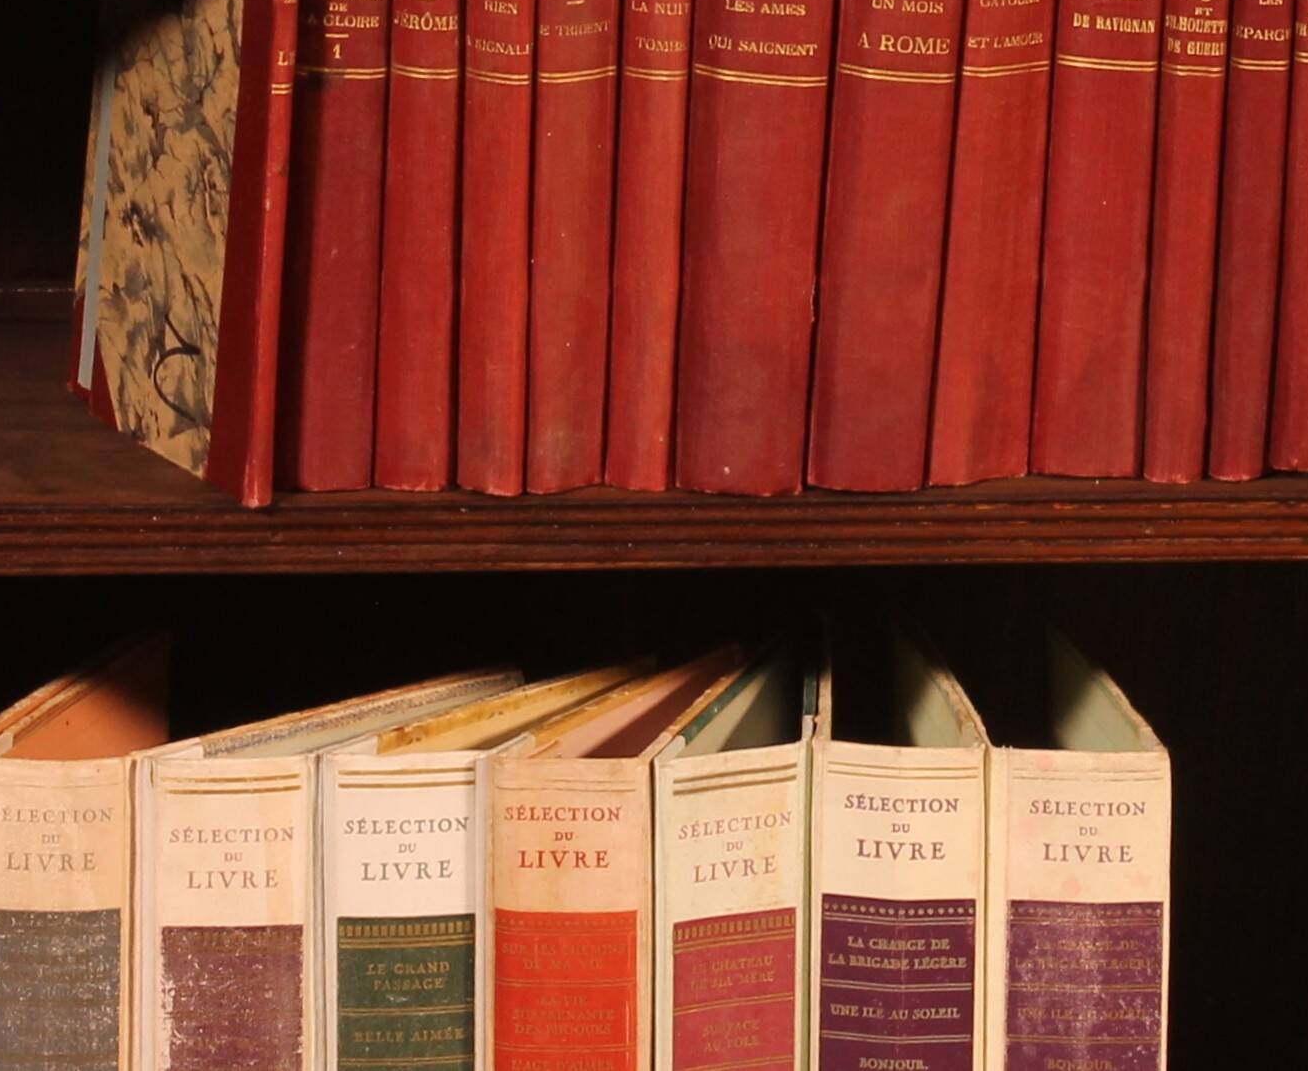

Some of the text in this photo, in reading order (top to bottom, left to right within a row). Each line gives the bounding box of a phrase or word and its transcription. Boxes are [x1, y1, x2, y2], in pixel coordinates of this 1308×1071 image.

[329, 3, 348, 12] DE
[484, 0, 518, 15] RIEN
[631, 0, 649, 12] LA
[761, 4, 806, 16] AMES
[902, 0, 943, 14] MOIS
[323, 15, 379, 27] GLOIRE
[395, 11, 458, 30] JÉRÔME
[1073, 14, 1155, 34] DE RAVIGNAN
[1165, 14, 1227, 34] SILHOUETT
[709, 36, 817, 56] QUI SAIGNENT
[858, 32, 950, 55] A ROME
[968, 32, 1043, 49] ET L'AMOUR
[332, 45, 342, 60] 1
[844, 793, 959, 814] SÉLECTION
[1029, 798, 1146, 818] SÉLECTION
[504, 804, 622, 822] SÉLECTION
[344, 817, 469, 835] SÉLECTION
[678, 810, 792, 841] SÉLECTION
[891, 823, 910, 834] DU
[1079, 826, 1098, 836] DU
[42, 833, 61, 844] DU
[169, 825, 294, 843] SÉLECTION
[554, 831, 574, 842] DU
[398, 842, 417, 853] DU
[726, 841, 743, 851] DU
[856, 839, 947, 860] LIVRE
[1043, 843, 1133, 863] LIVRE
[6, 851, 97, 872] LIVRE
[223, 851, 243, 863] DU
[518, 850, 610, 869] LIVRE
[361, 859, 453, 881] LIVRE
[693, 855, 777, 884] LIVRE
[187, 869, 279, 889] LIVRE
[847, 936, 950, 950] LA CHARGE DE
[366, 960, 450, 976] LE GRAND
[828, 953, 845, 964] LA
[850, 955, 909, 969] BRIGADE
[373, 976, 446, 991] PASSAGE
[830, 1004, 859, 1016] UNE
[889, 1010, 908, 1019] AU
[913, 1008, 960, 1019] SOLEIL
